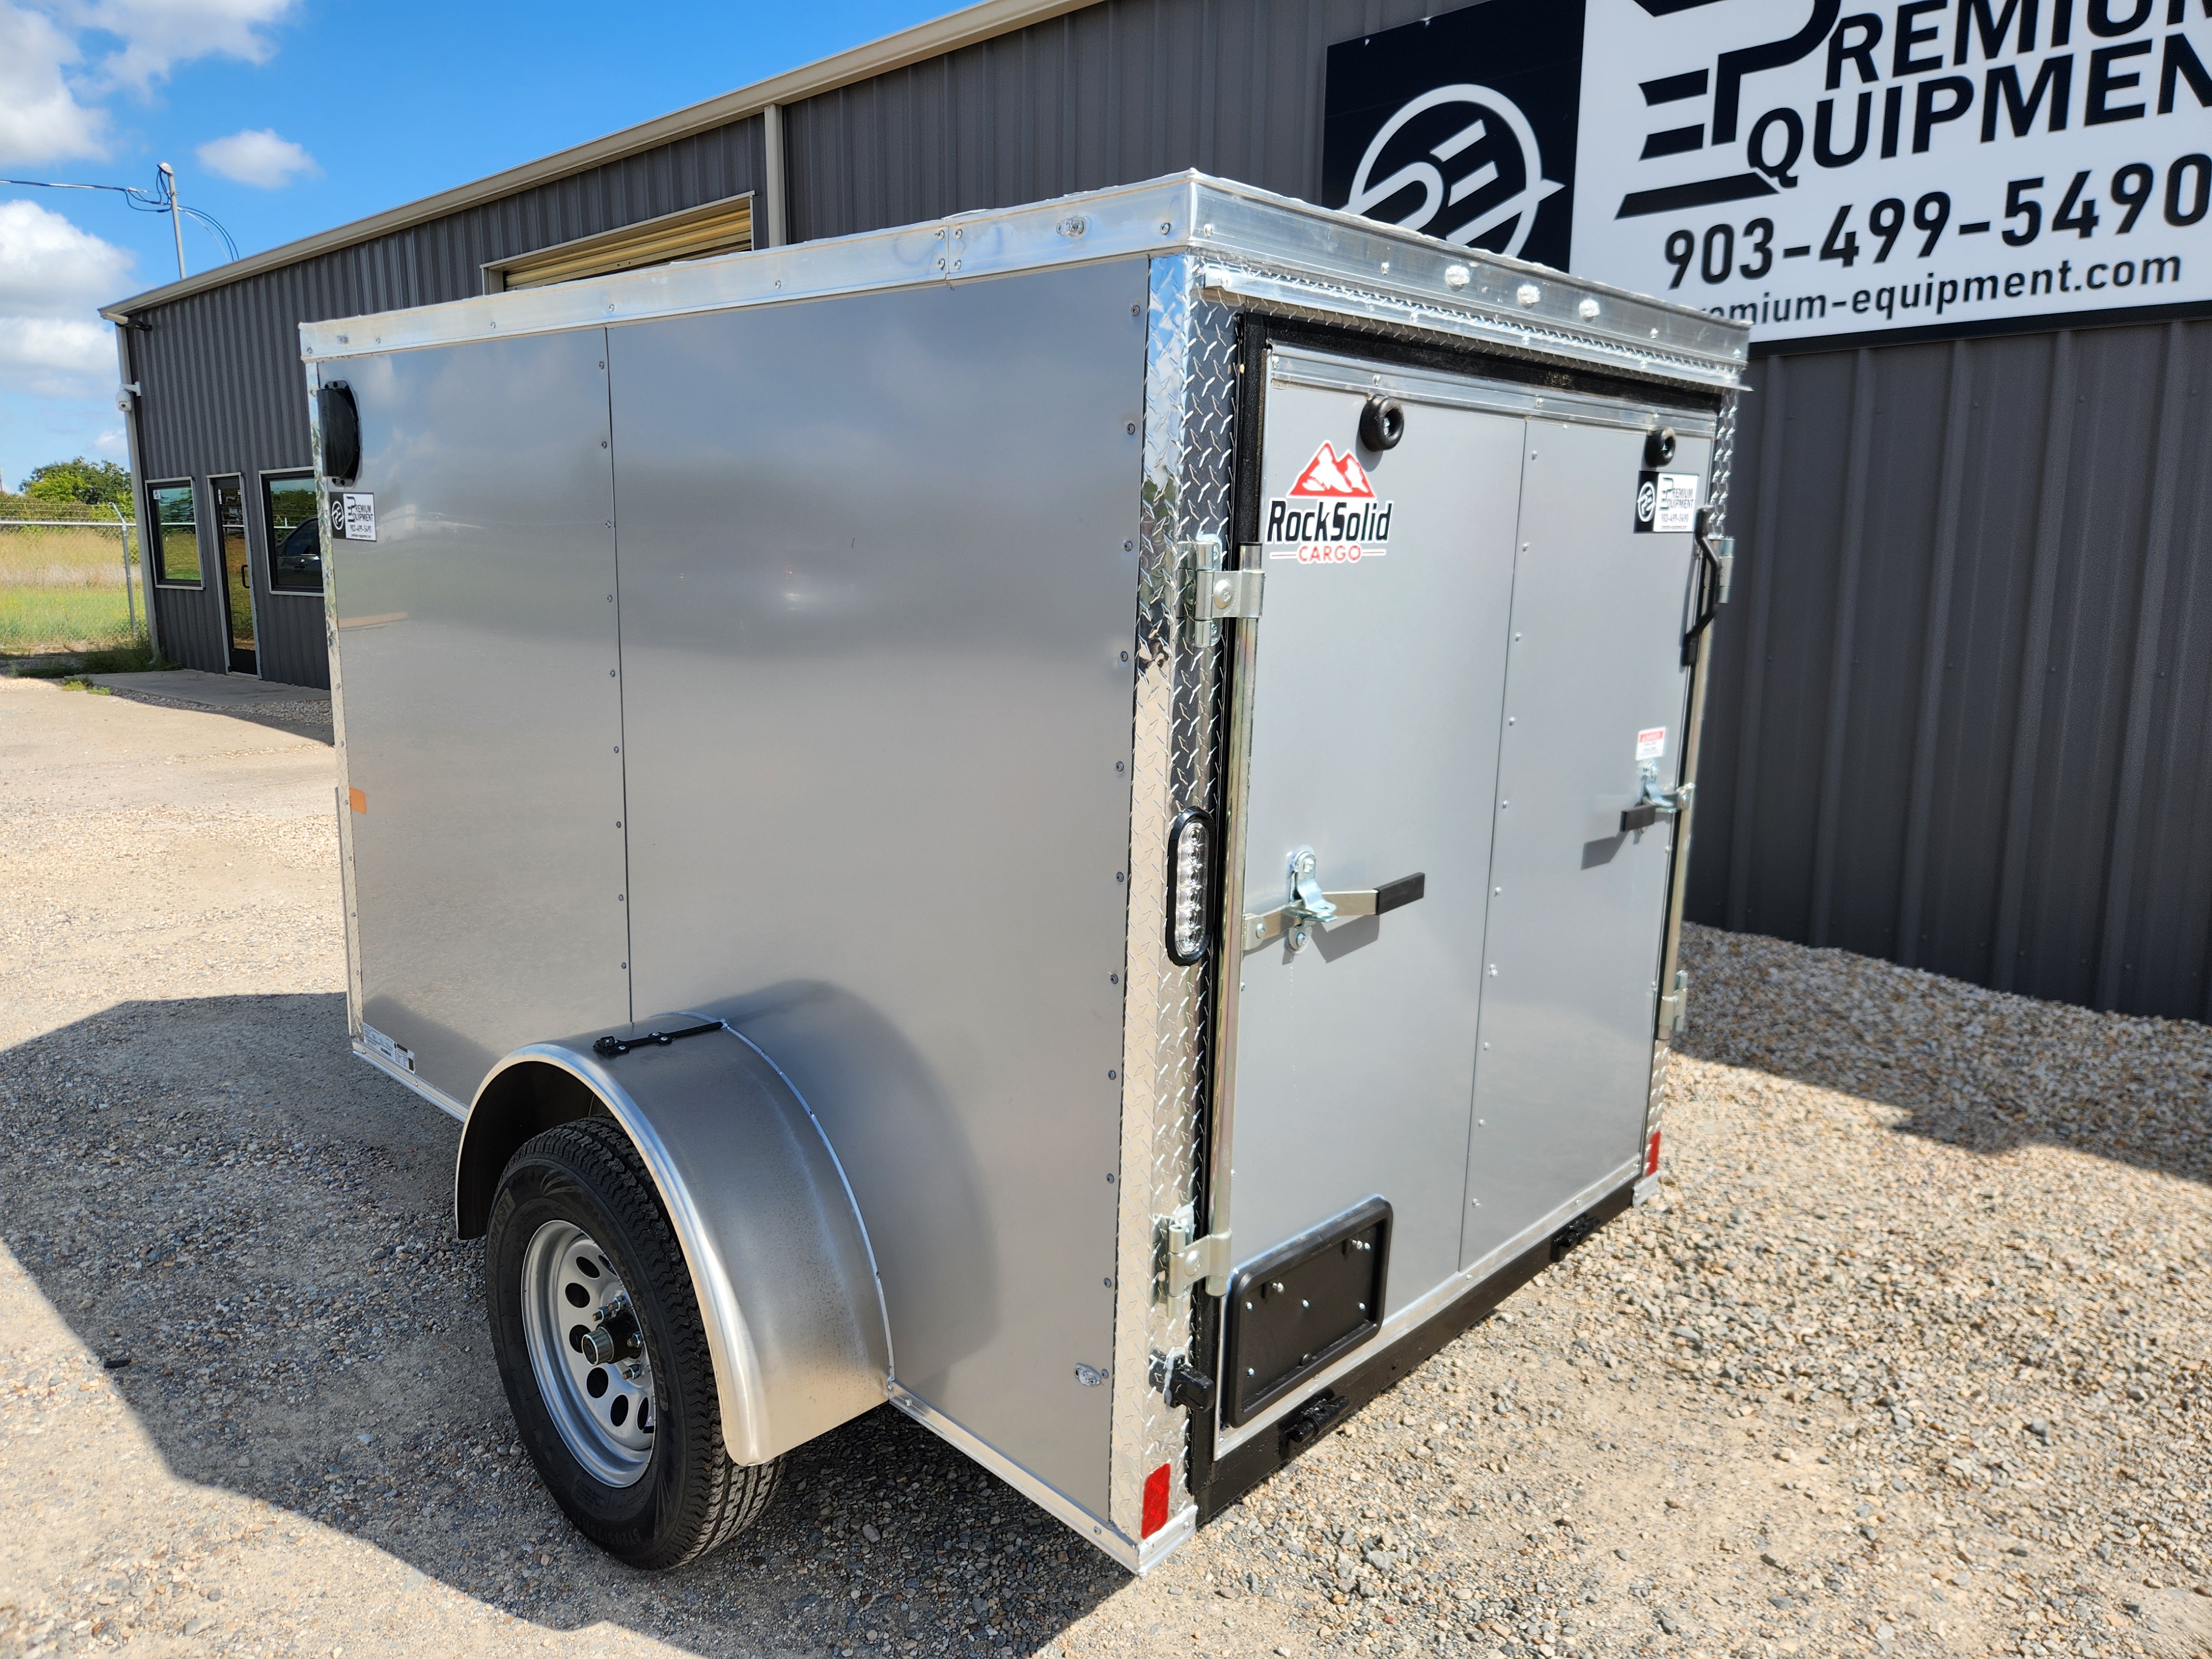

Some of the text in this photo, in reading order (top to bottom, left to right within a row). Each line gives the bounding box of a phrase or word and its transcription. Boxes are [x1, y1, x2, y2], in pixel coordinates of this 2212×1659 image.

[1664, 153, 2212, 290] 903-499-5490
[1699, 255, 2182, 325] mium-equipment.com
[1266, 500, 1393, 542] RockSolid
[1298, 545, 1361, 562] CARGO
